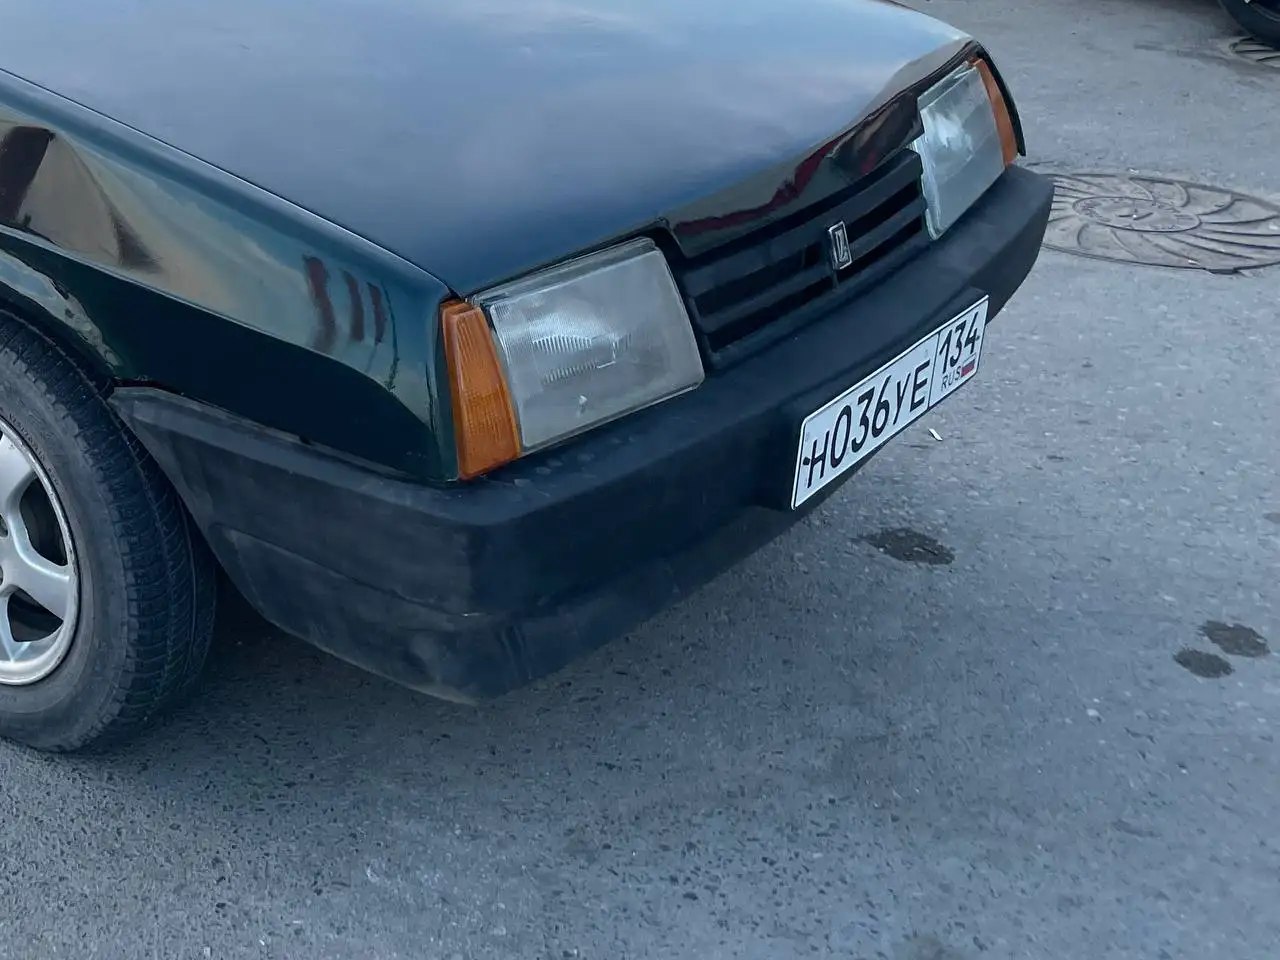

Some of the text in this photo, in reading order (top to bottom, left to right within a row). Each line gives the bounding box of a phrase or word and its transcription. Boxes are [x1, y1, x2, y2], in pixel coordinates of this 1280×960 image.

[806, 311, 978, 488] Н036УЕ 134
[941, 365, 961, 391] RUS
